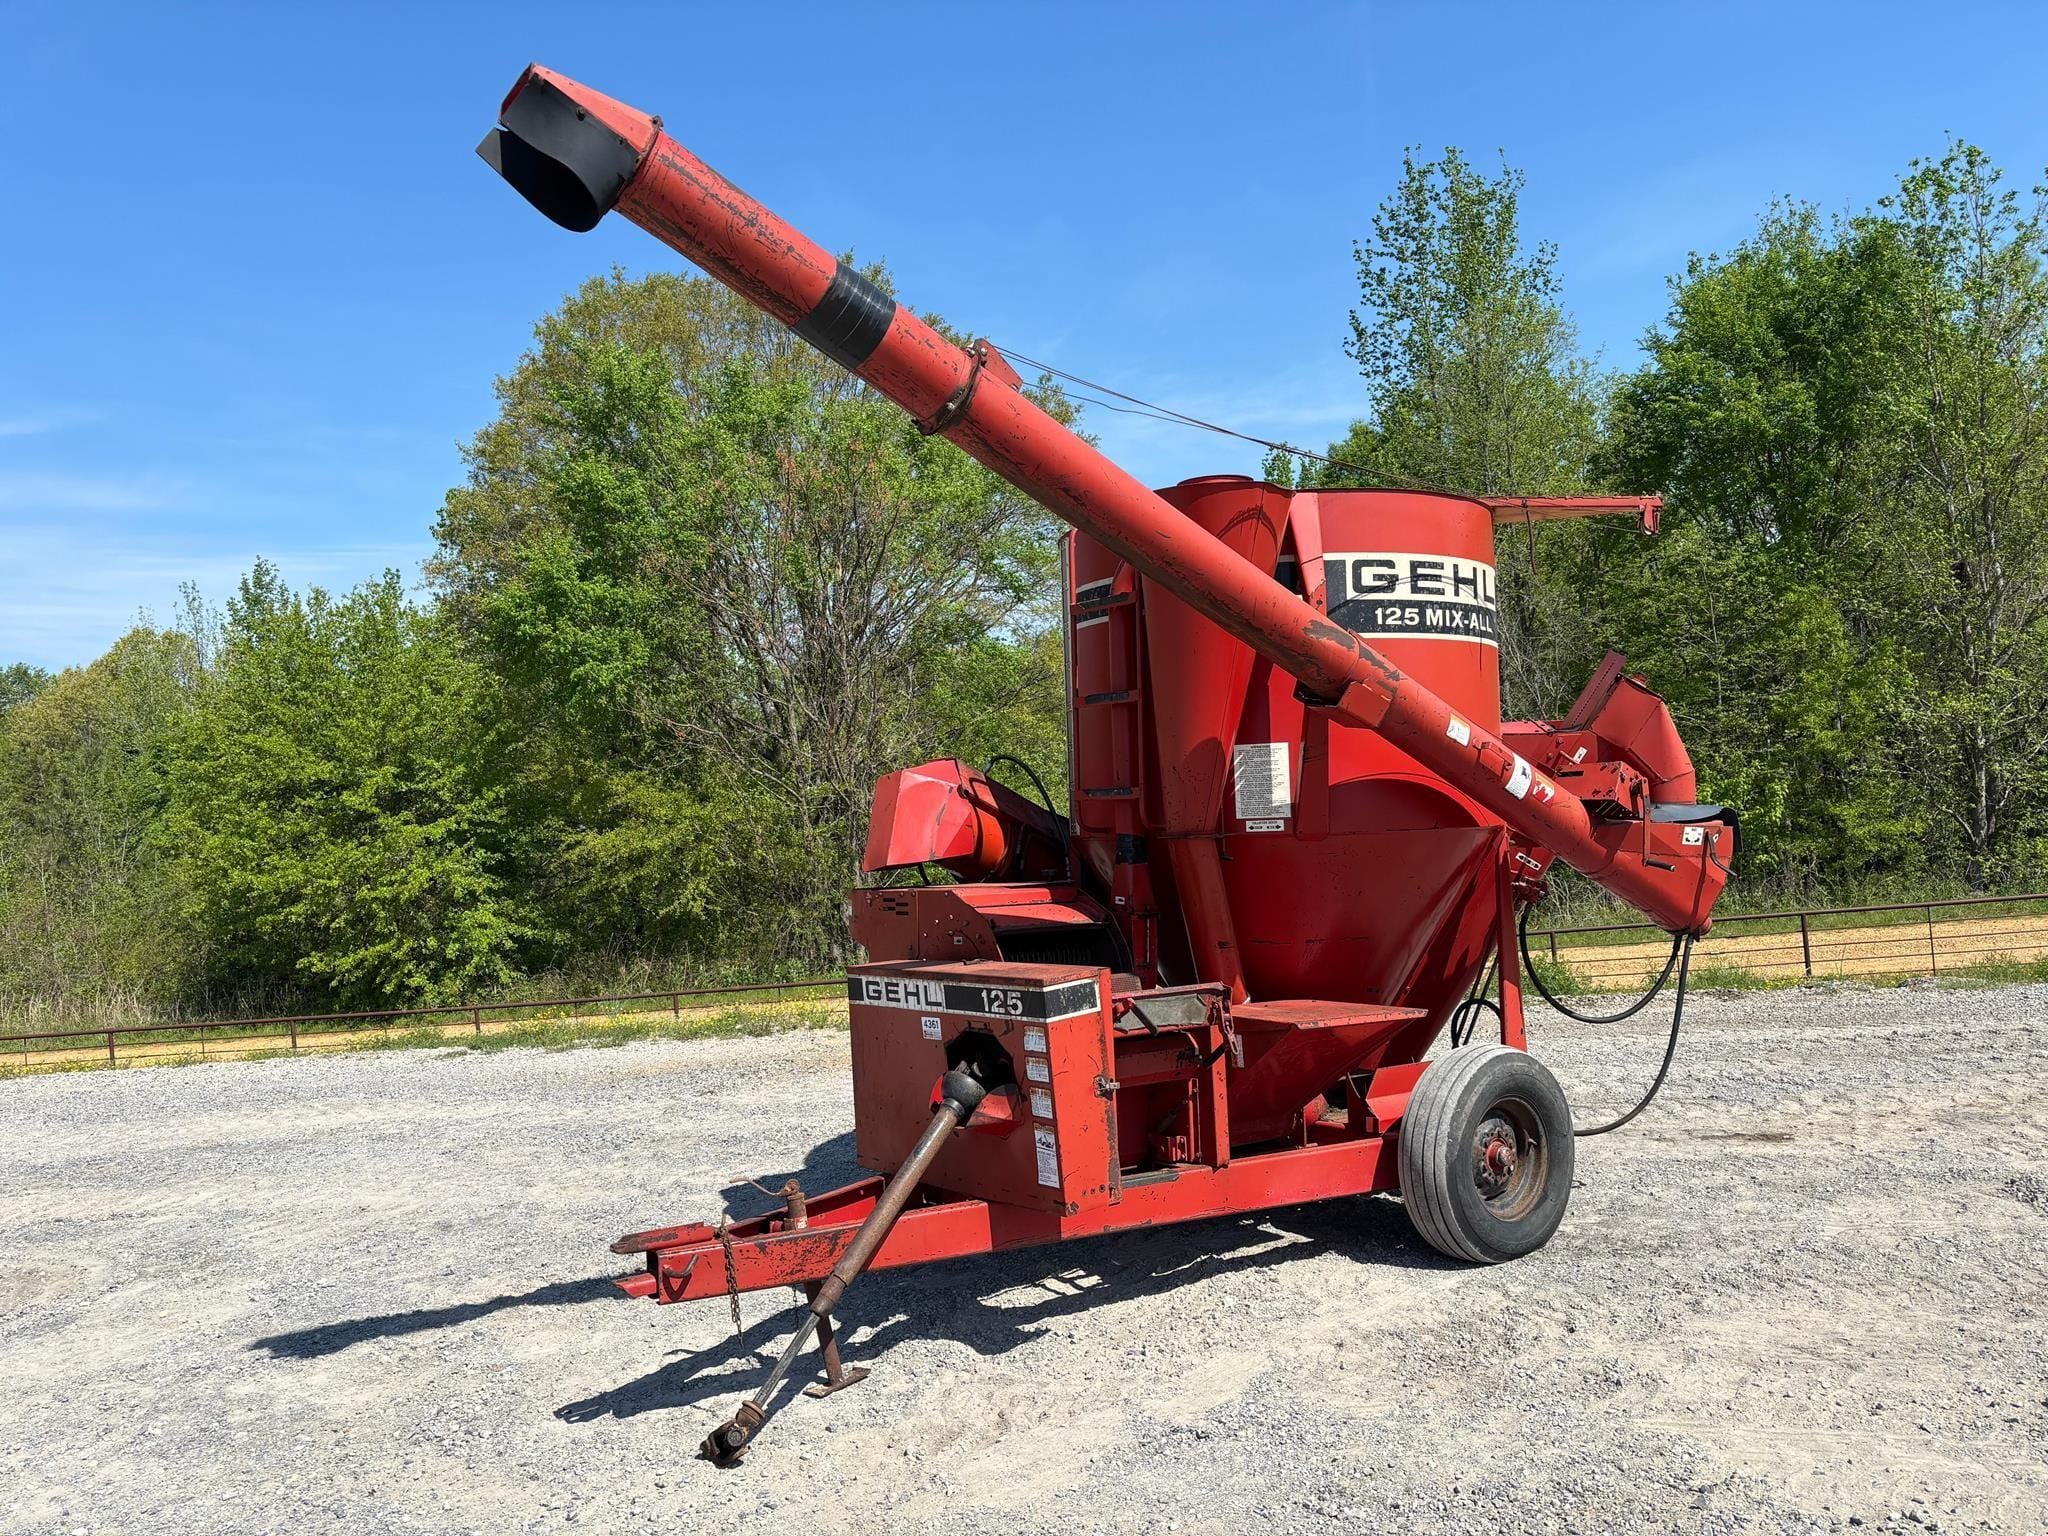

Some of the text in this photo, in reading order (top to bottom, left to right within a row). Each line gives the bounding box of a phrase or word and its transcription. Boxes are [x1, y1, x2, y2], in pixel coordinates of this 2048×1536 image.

[1352, 559, 1495, 605] GEHL
[1374, 607, 1493, 633] 125 MIX-ALL
[865, 980, 1024, 1016] GEHL 125
[923, 1019, 940, 1030] 4361
